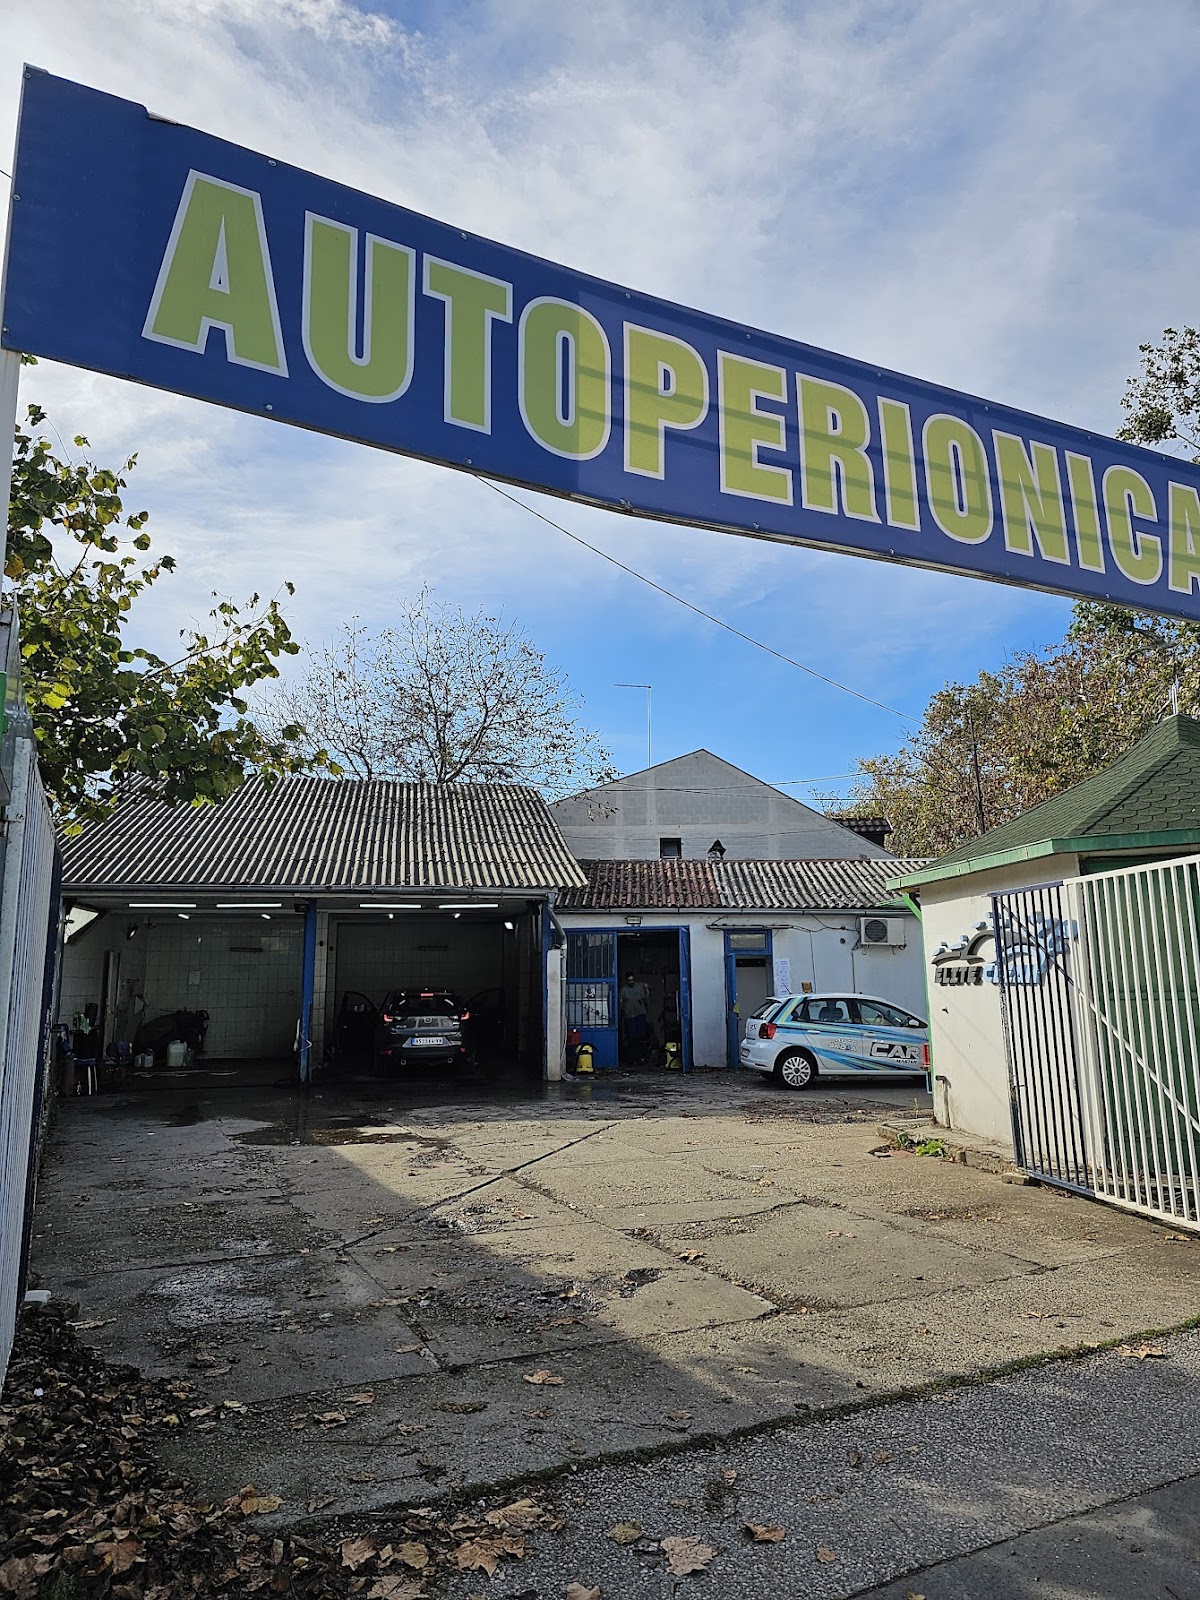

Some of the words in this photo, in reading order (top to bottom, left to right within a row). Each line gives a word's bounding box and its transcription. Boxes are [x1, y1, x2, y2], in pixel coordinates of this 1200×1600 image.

[141, 168, 1200, 595] AUTOPERIONICA
[934, 965, 983, 986] ELITE
[835, 1037, 859, 1047] AUTO
[870, 1042, 921, 1060] CAR
